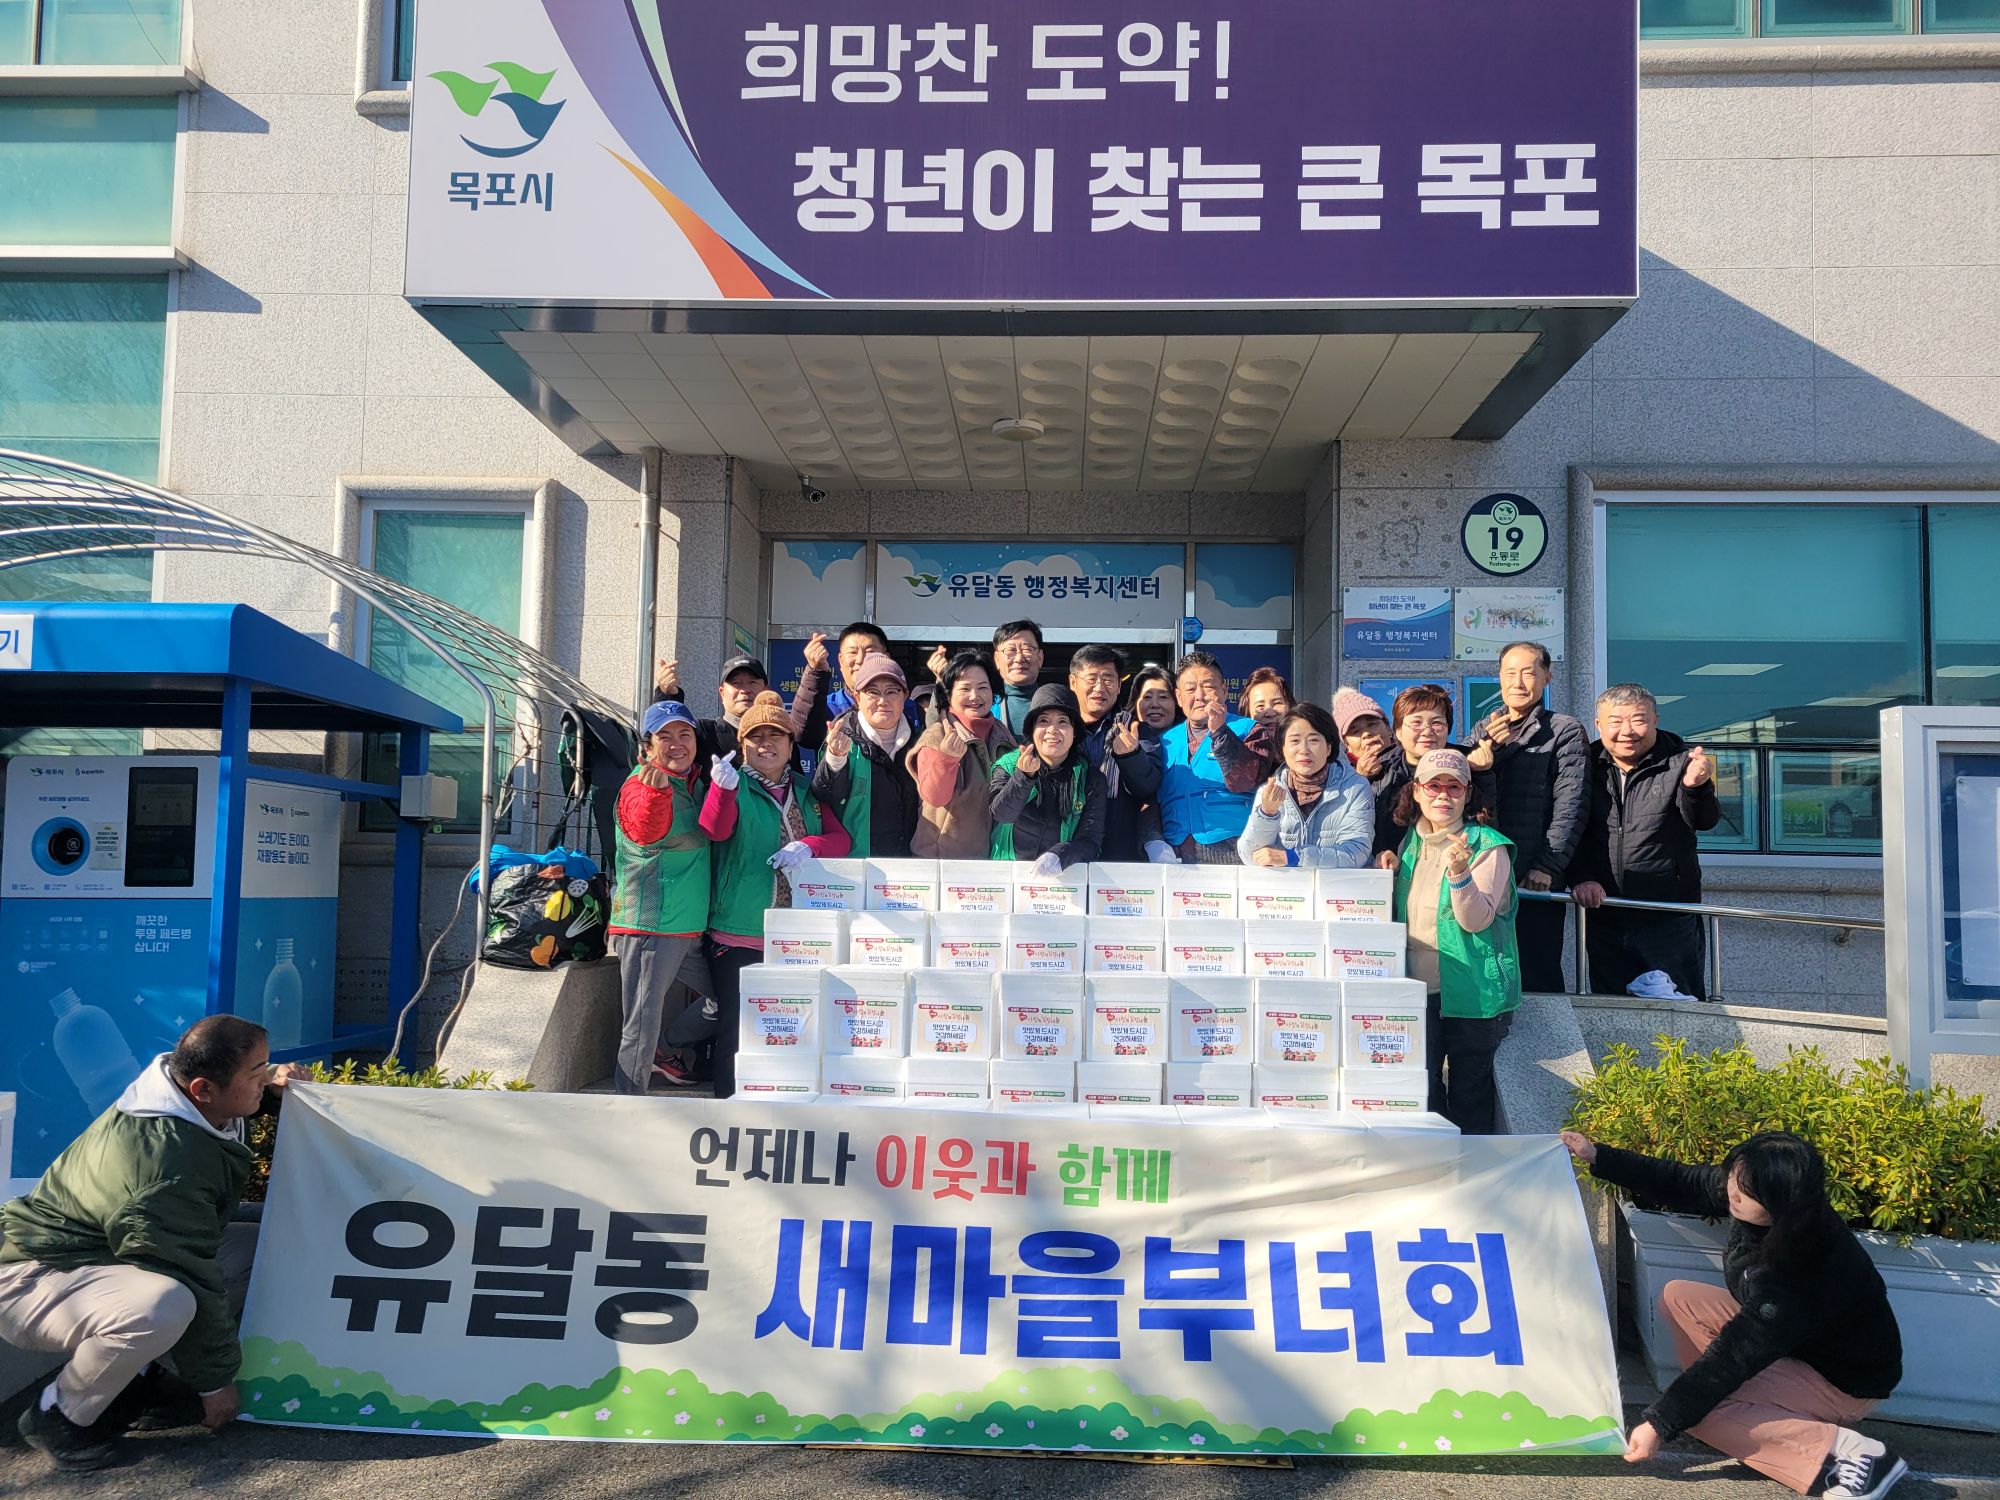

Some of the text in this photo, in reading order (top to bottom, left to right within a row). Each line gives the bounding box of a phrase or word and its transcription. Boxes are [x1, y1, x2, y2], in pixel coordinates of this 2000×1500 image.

[741, 20, 1231, 103] 희망찬 도약!
[447, 172, 554, 212] 목포시
[793, 143, 1600, 233] 청년이 찾는 큰 목포
[1487, 527, 1524, 550] 19
[947, 573, 1161, 600] 유달동 행정복지센터
[1357, 630, 1438, 640] 유달동 행정복지센터
[258, 830, 310, 847] 쓰레기도 돈이다.
[257, 850, 287, 864] 재활용도
[136, 915, 168, 926] 깨끗한
[136, 928, 192, 940] 투명 페트병
[848, 1019, 865, 1027] 맛있게
[951, 1024, 968, 1032] 드시고
[688, 1127, 1172, 1208] 언제나 이웃과 함께
[330, 1199, 1525, 1366] 유달동 새마을부녀회
